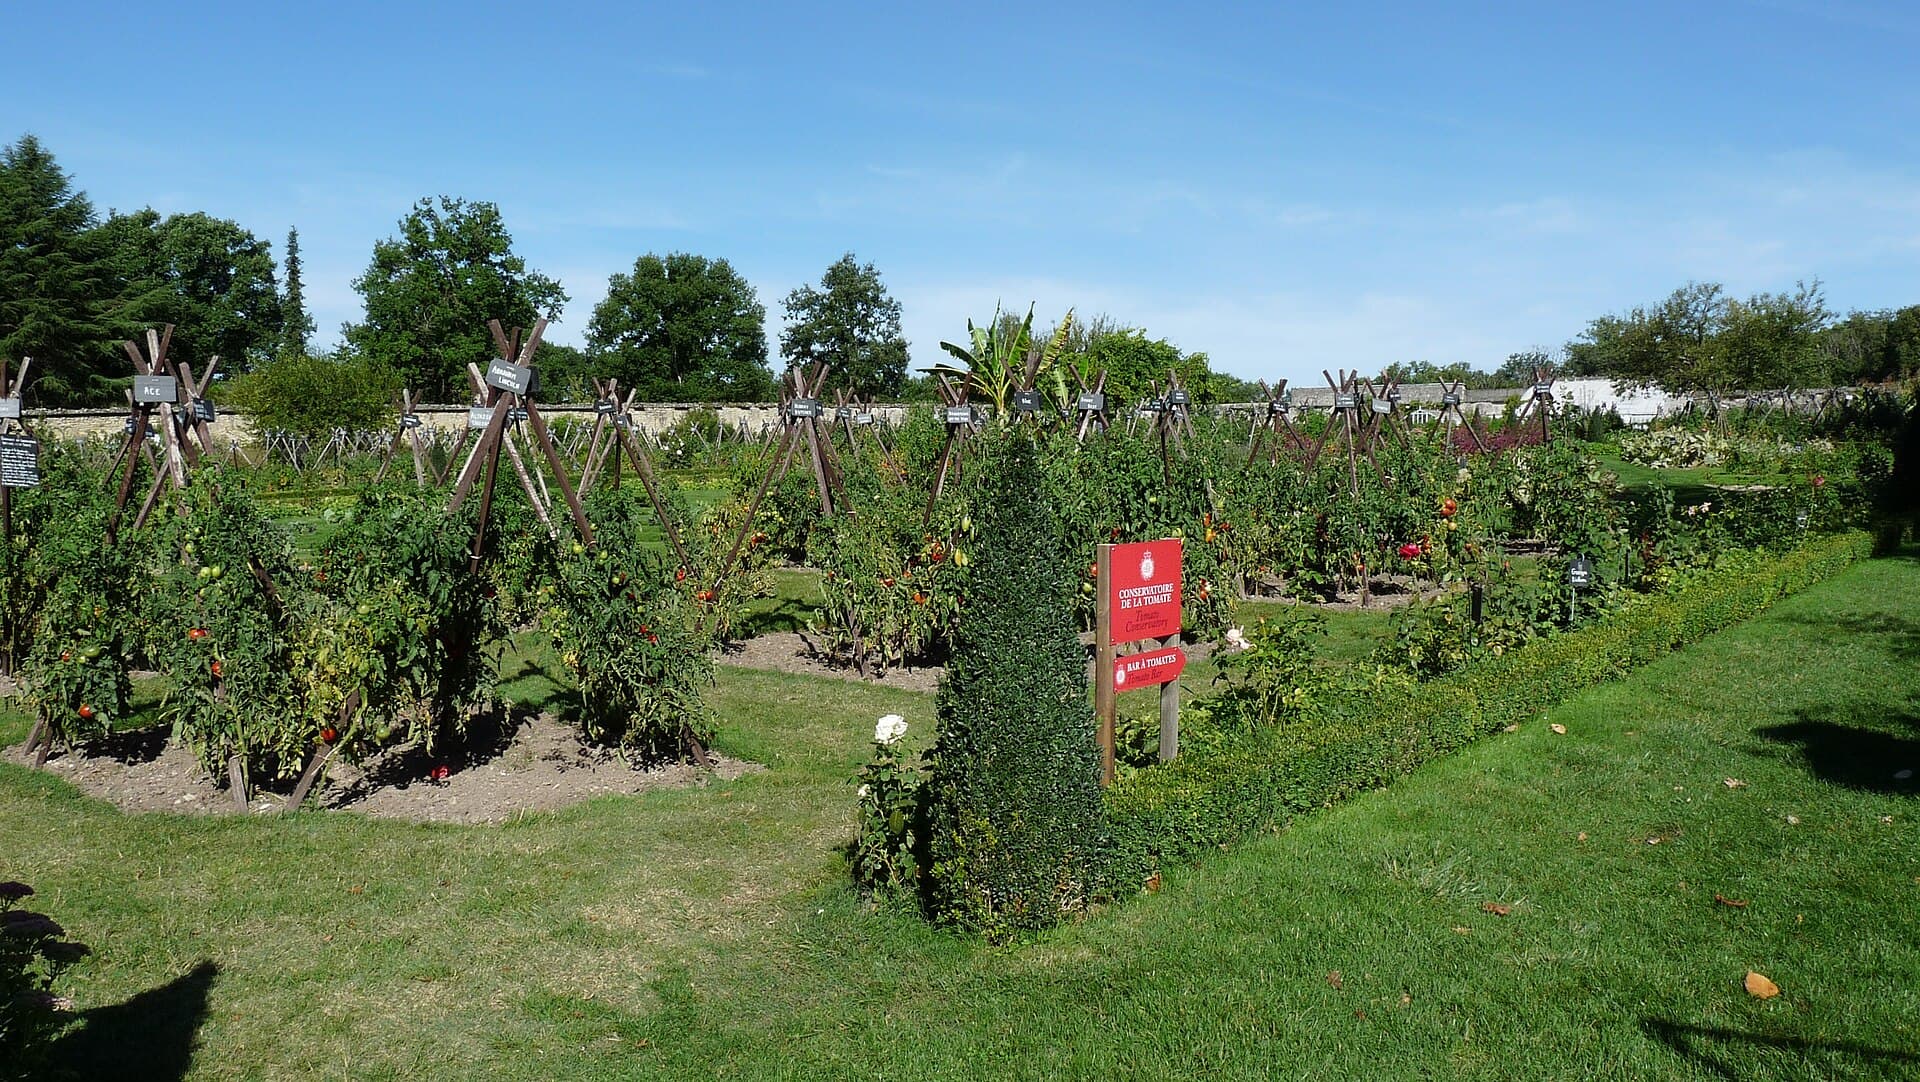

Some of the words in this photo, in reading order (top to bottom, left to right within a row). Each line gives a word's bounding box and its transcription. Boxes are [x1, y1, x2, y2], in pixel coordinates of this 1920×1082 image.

[144, 386, 161, 396] ACE
[1119, 583, 1174, 599] CONSERVATOIRE
[1121, 599, 1132, 609] DE
[1133, 597, 1142, 608] LA
[1144, 593, 1172, 606] TOMATE
[1127, 661, 1140, 672] BAR
[1140, 658, 1146, 670] À
[1146, 654, 1177, 668] TOMATES
